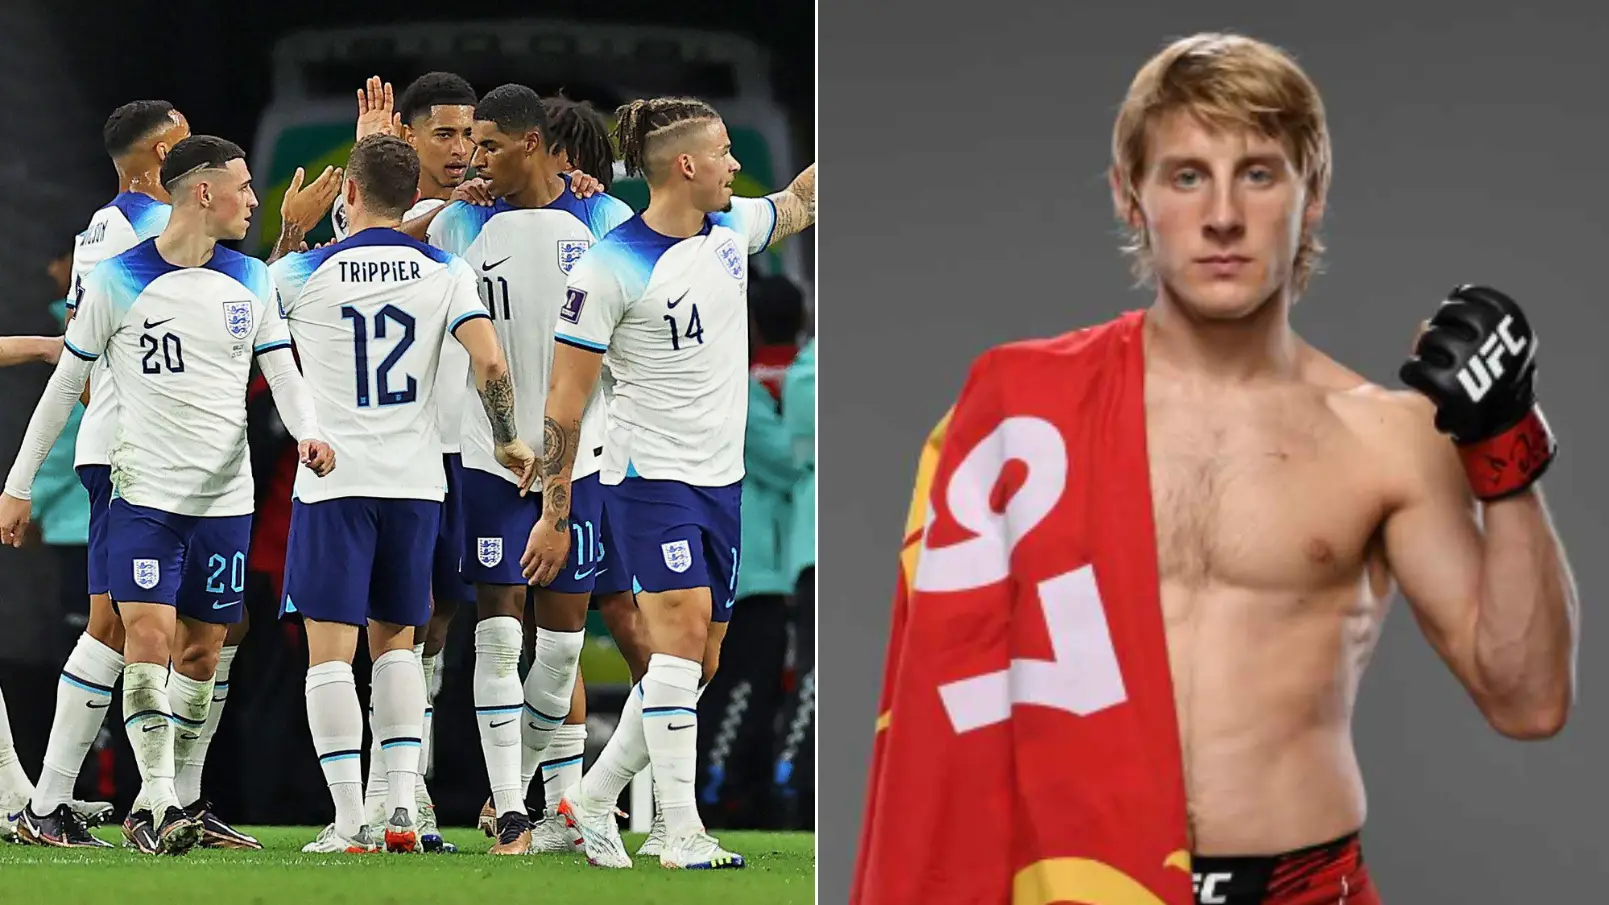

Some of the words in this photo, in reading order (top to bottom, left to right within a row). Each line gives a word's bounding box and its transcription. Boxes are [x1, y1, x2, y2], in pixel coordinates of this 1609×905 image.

[482, 275, 511, 321] 11
[663, 302, 704, 351] 14
[139, 331, 186, 374] 20
[340, 303, 418, 408] 12
[1456, 314, 1527, 403] UFC
[572, 520, 594, 566] 11
[205, 550, 245, 594] 20
[914, 415, 1128, 735] 97
